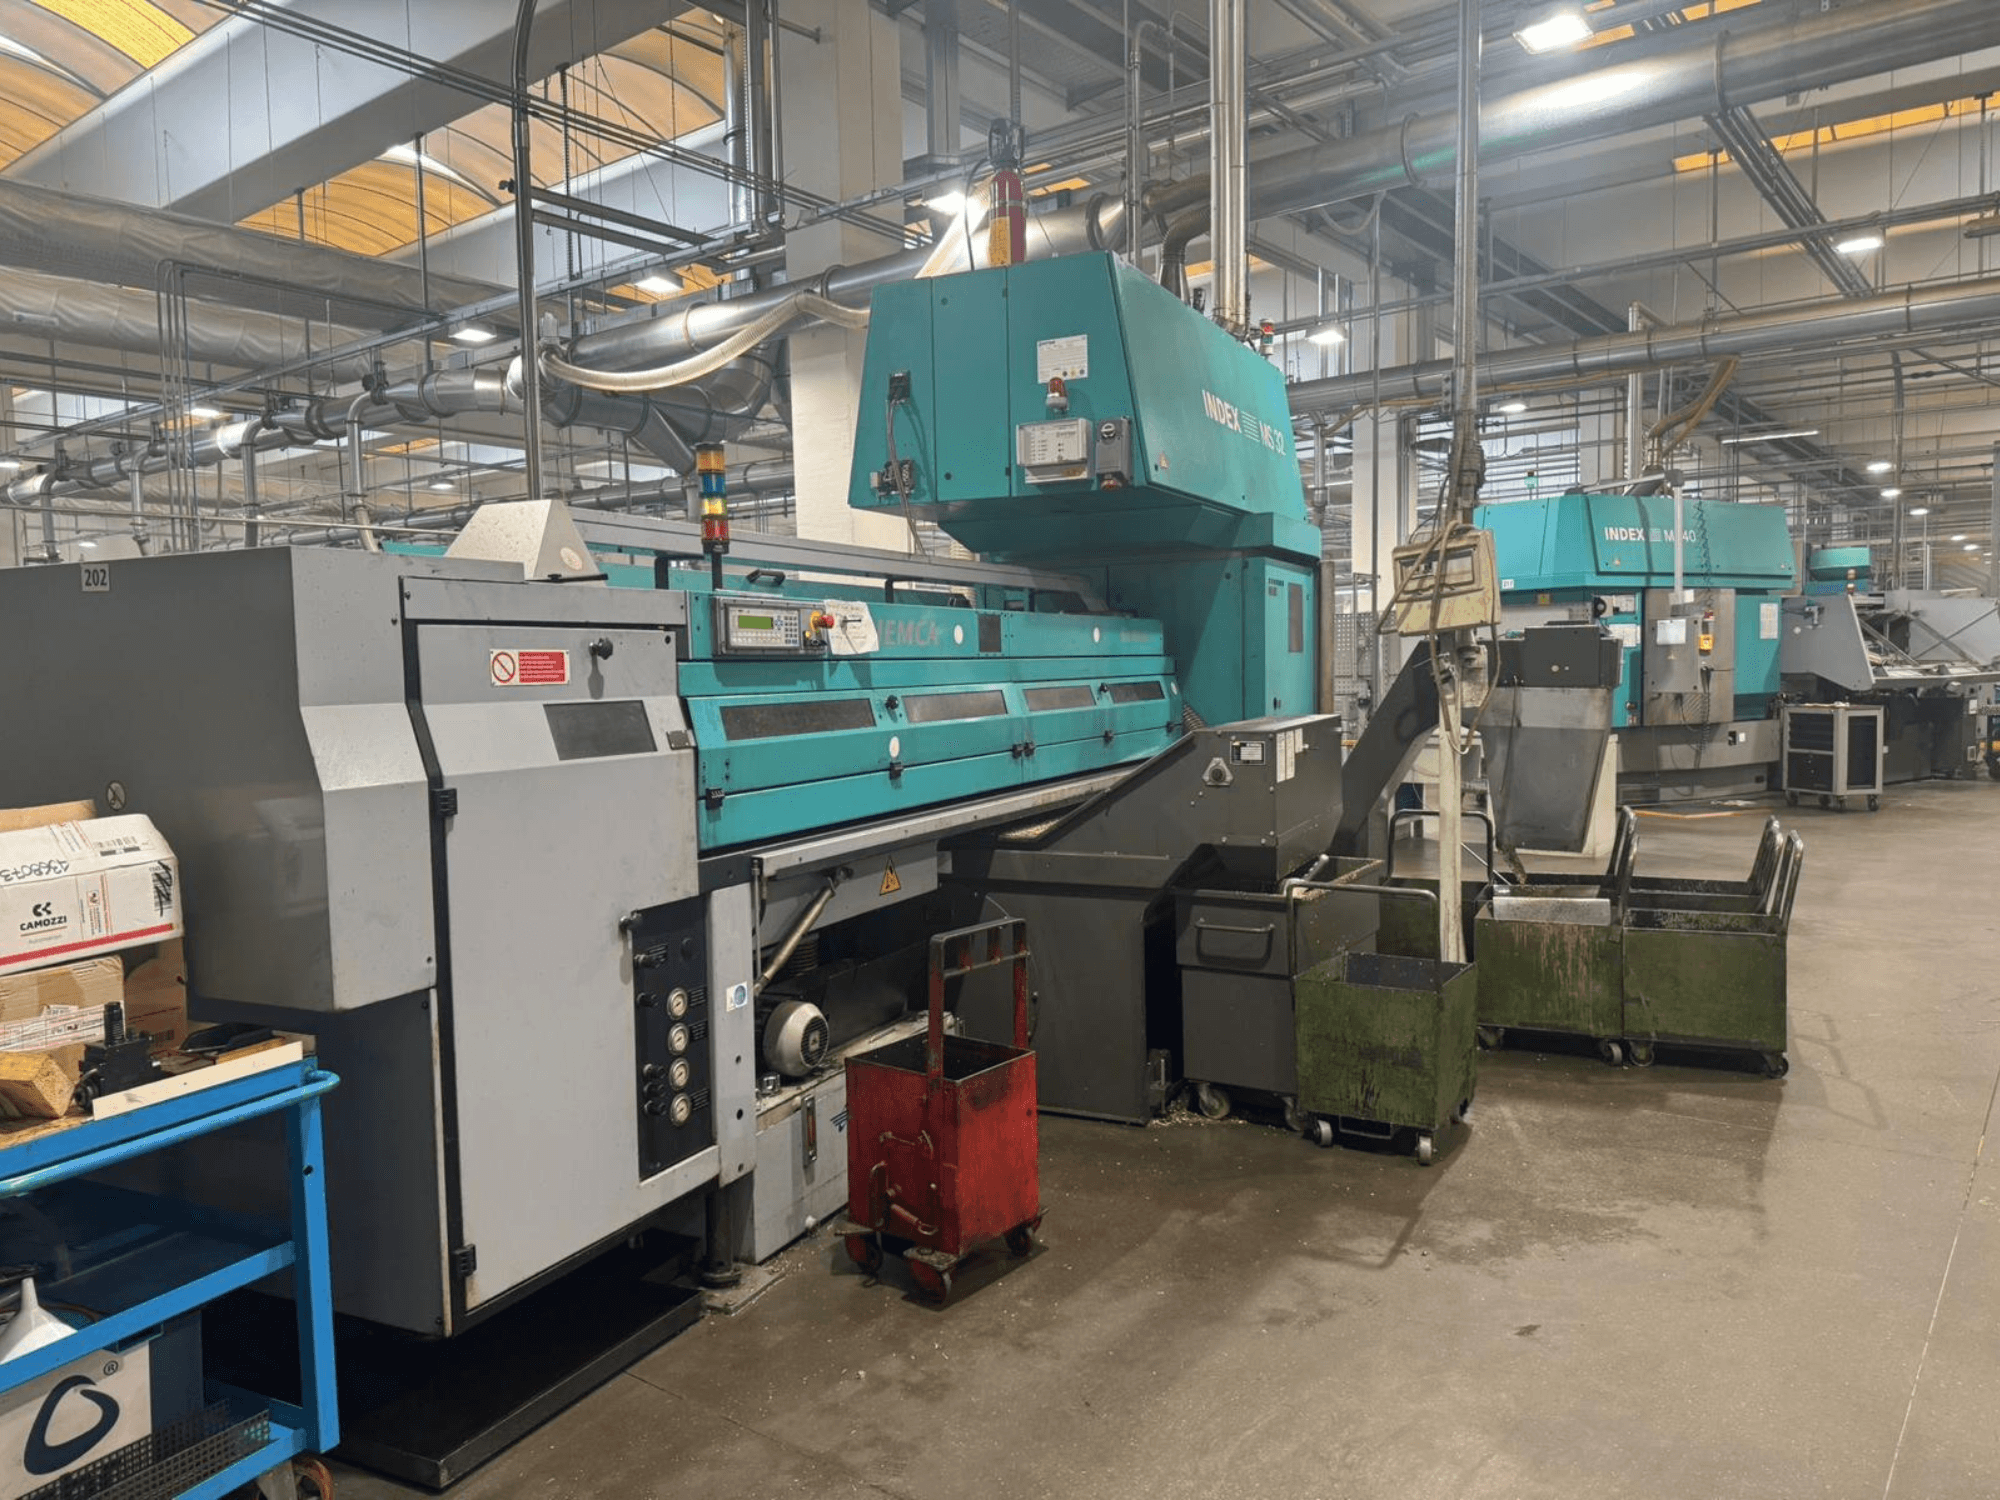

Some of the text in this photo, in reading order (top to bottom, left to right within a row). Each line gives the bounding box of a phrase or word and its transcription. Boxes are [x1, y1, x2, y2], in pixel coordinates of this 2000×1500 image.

[1202, 389, 1242, 434] INDEX
[1259, 420, 1275, 451] MS
[1604, 526, 1645, 541] INDEX
[84, 568, 108, 587] 202
[20, 915, 67, 931] CAMOZZI
